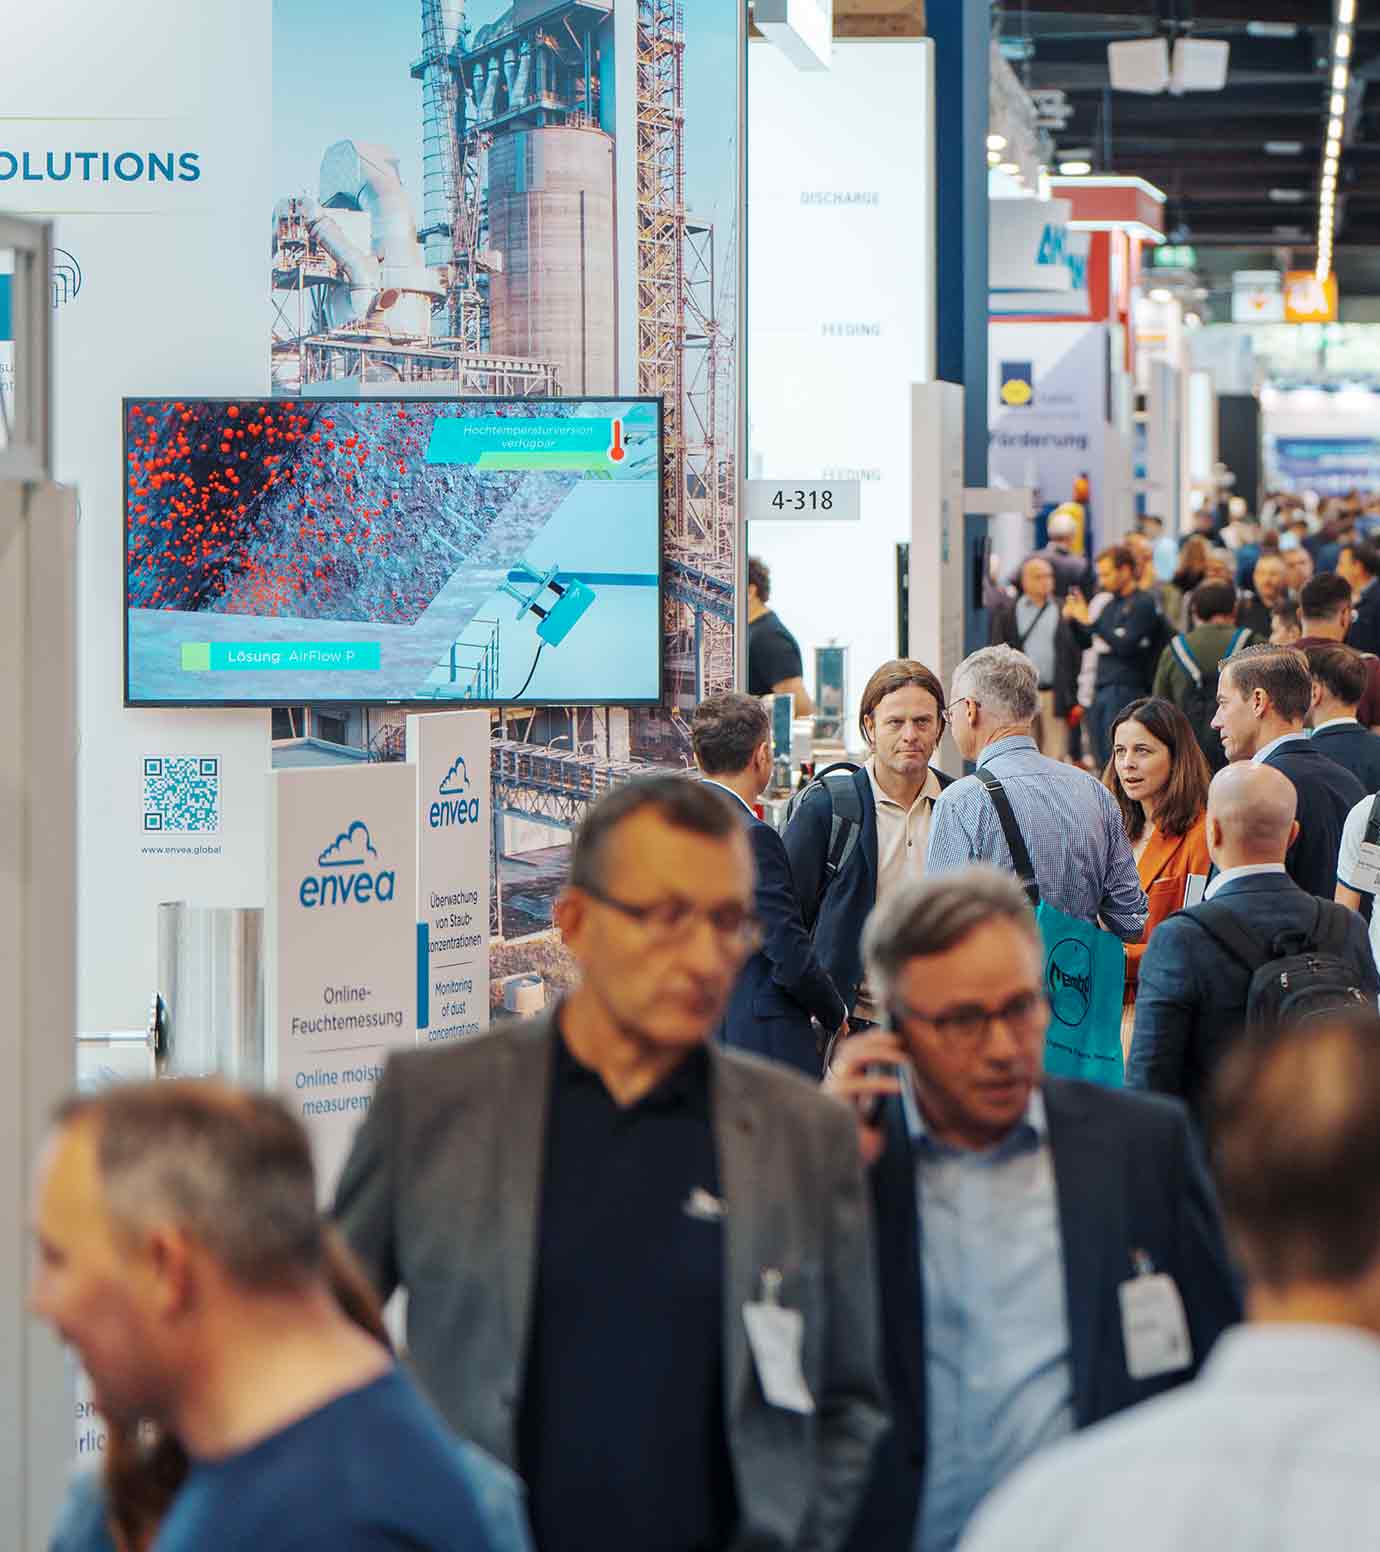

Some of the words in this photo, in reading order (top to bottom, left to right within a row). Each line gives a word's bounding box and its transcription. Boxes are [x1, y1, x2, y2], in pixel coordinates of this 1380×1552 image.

[799, 191, 880, 206] DISCHARGE
[821, 322, 881, 337] FEEDING
[772, 490, 833, 510] 4-318
[288, 650, 341, 664] AirFlow
[346, 650, 355, 663] P
[429, 797, 480, 829] envea
[141, 845, 222, 855] www.envea.global
[300, 868, 396, 908] envea
[430, 889, 479, 909] Überwachung
[435, 916, 449, 929] von
[450, 912, 473, 928] Staub-
[323, 985, 372, 1004] Online-
[435, 979, 473, 996] Monitoring
[441, 1002, 450, 1017] of
[291, 1010, 404, 1036] Feuchtemessung
[295, 1067, 338, 1089] Online
